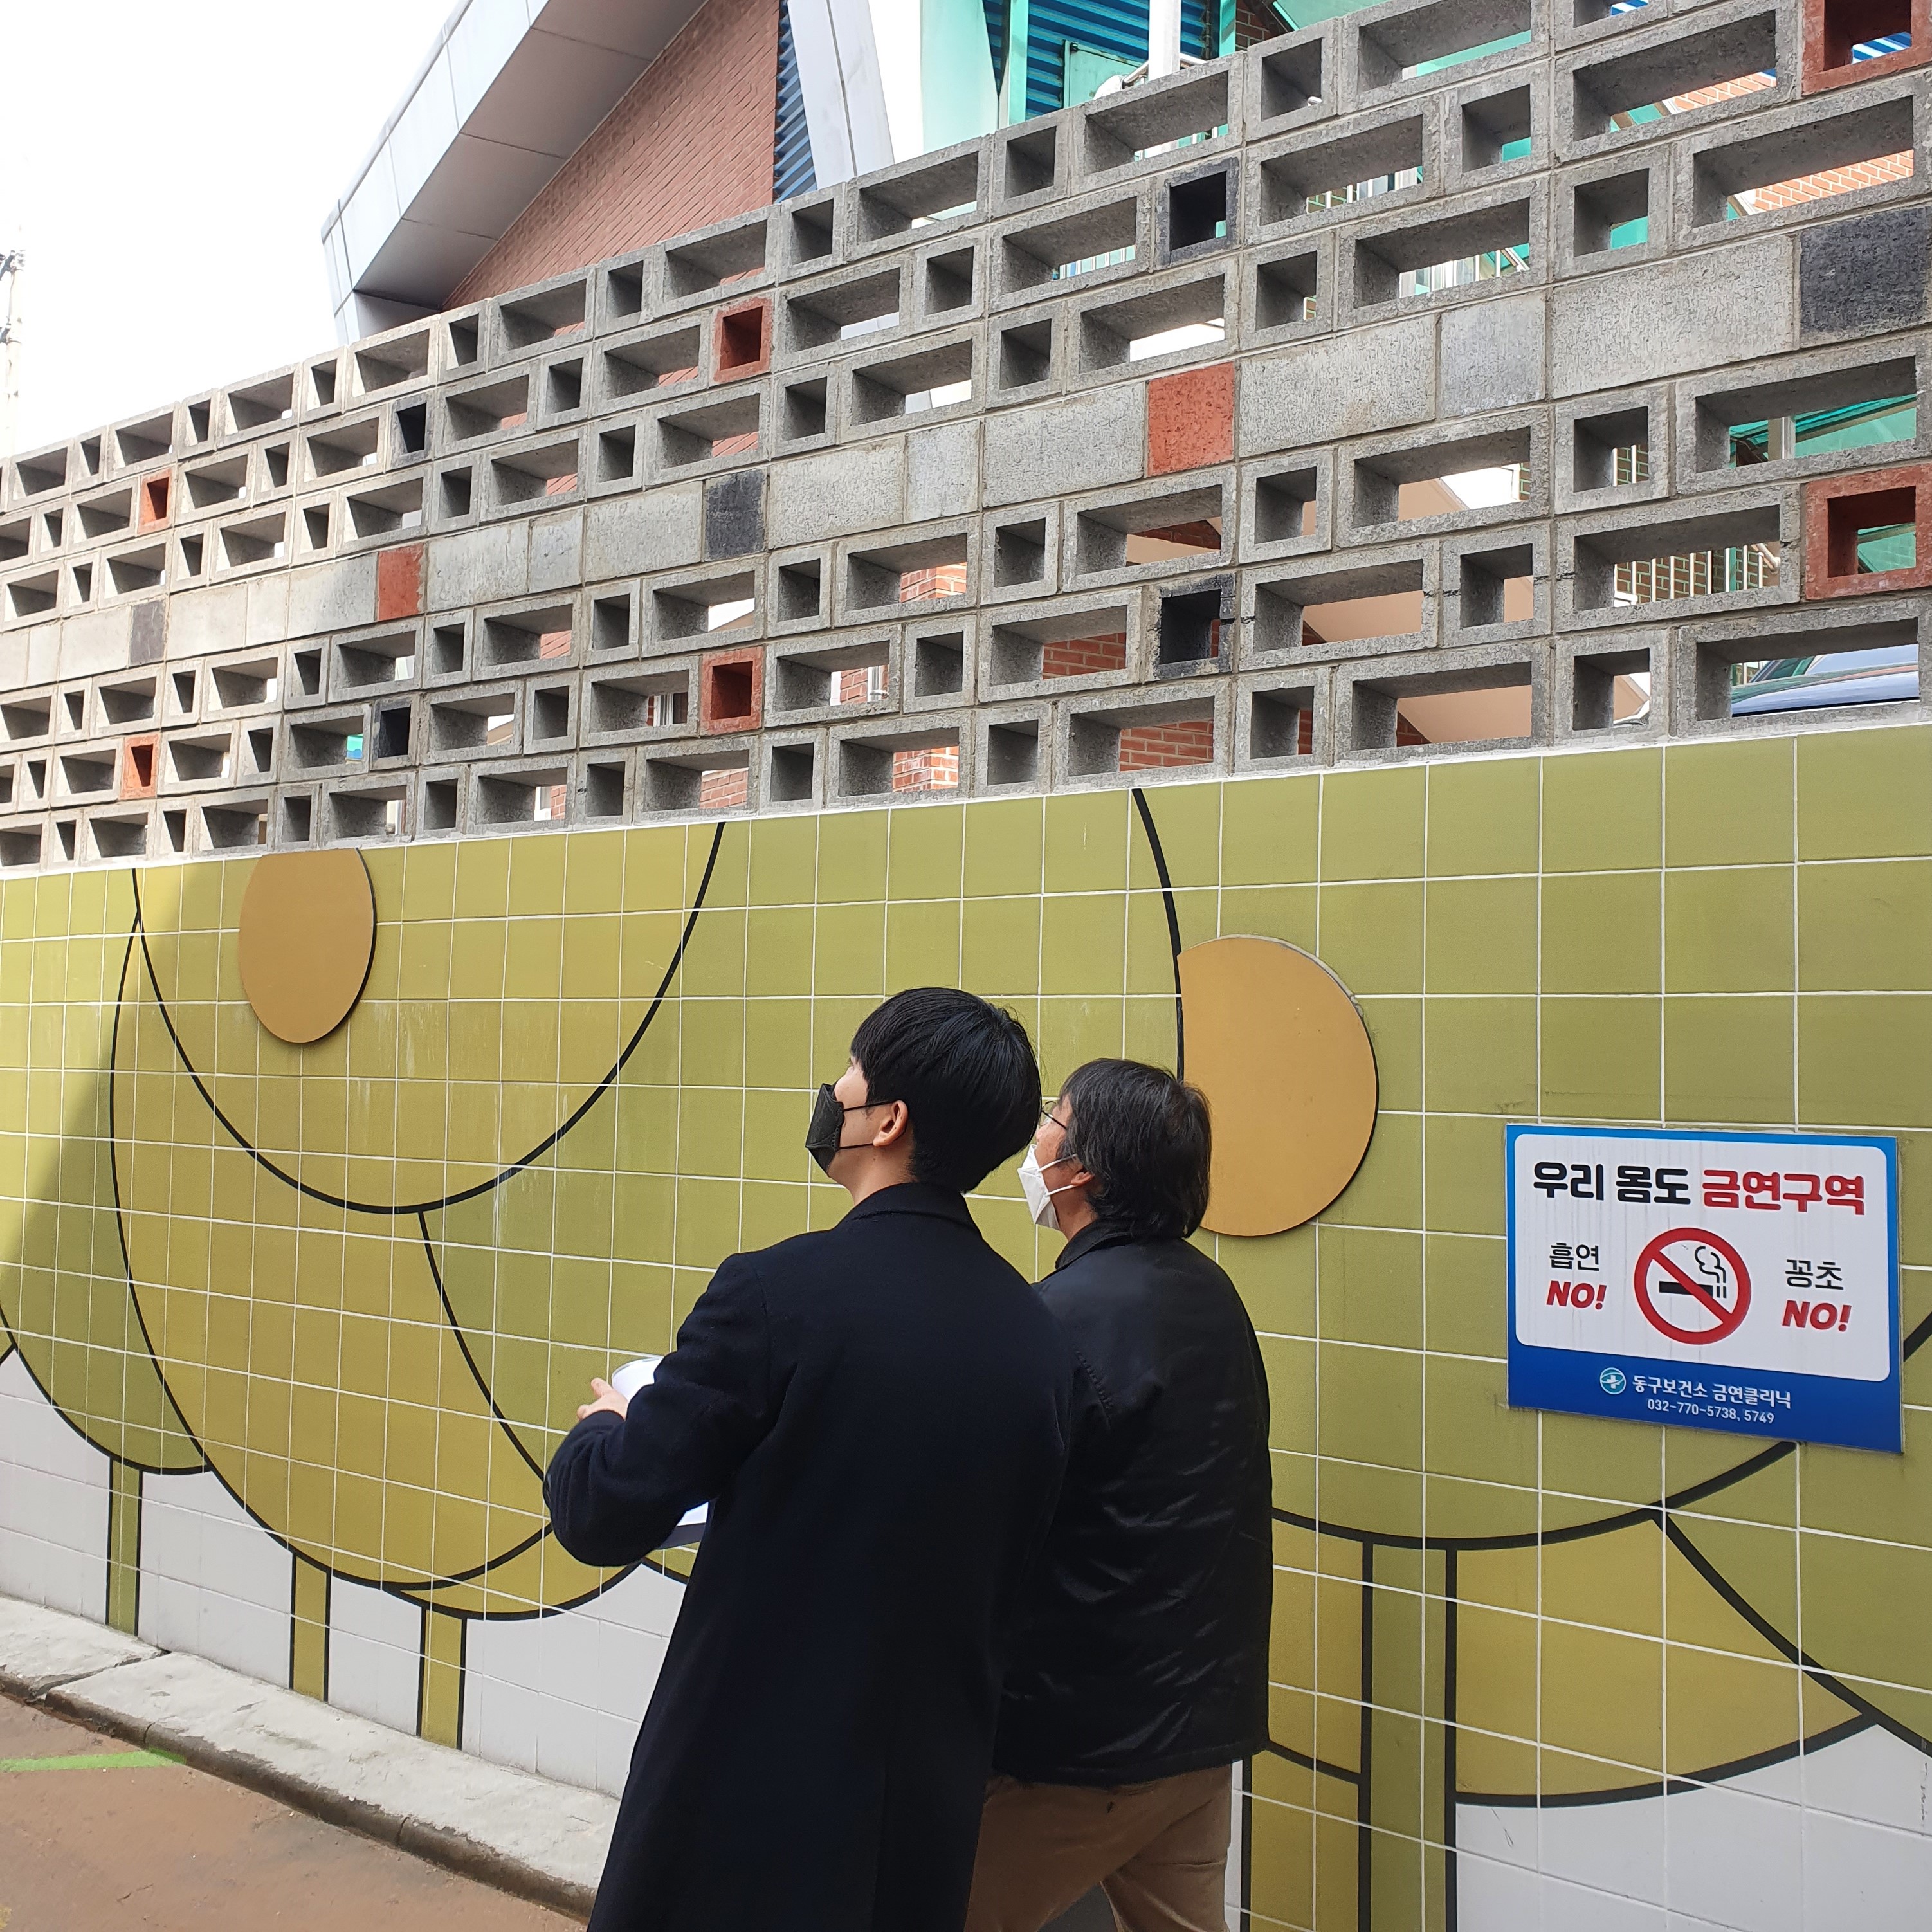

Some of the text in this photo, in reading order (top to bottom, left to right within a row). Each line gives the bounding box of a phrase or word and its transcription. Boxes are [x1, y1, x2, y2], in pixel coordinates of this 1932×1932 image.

[1533, 1162, 1864, 1215] 우리 몸도 금연구역
[1549, 1242, 1599, 1271] 흡연
[1785, 1259, 1844, 1290] 꽁초
[1546, 1281, 1607, 1310] NO!
[1782, 1300, 1852, 1331] NO!
[1632, 1375, 1791, 1409] 동구보건소 금연클리닉
[1647, 1399, 1774, 1425] 032-770-5738, 5749
